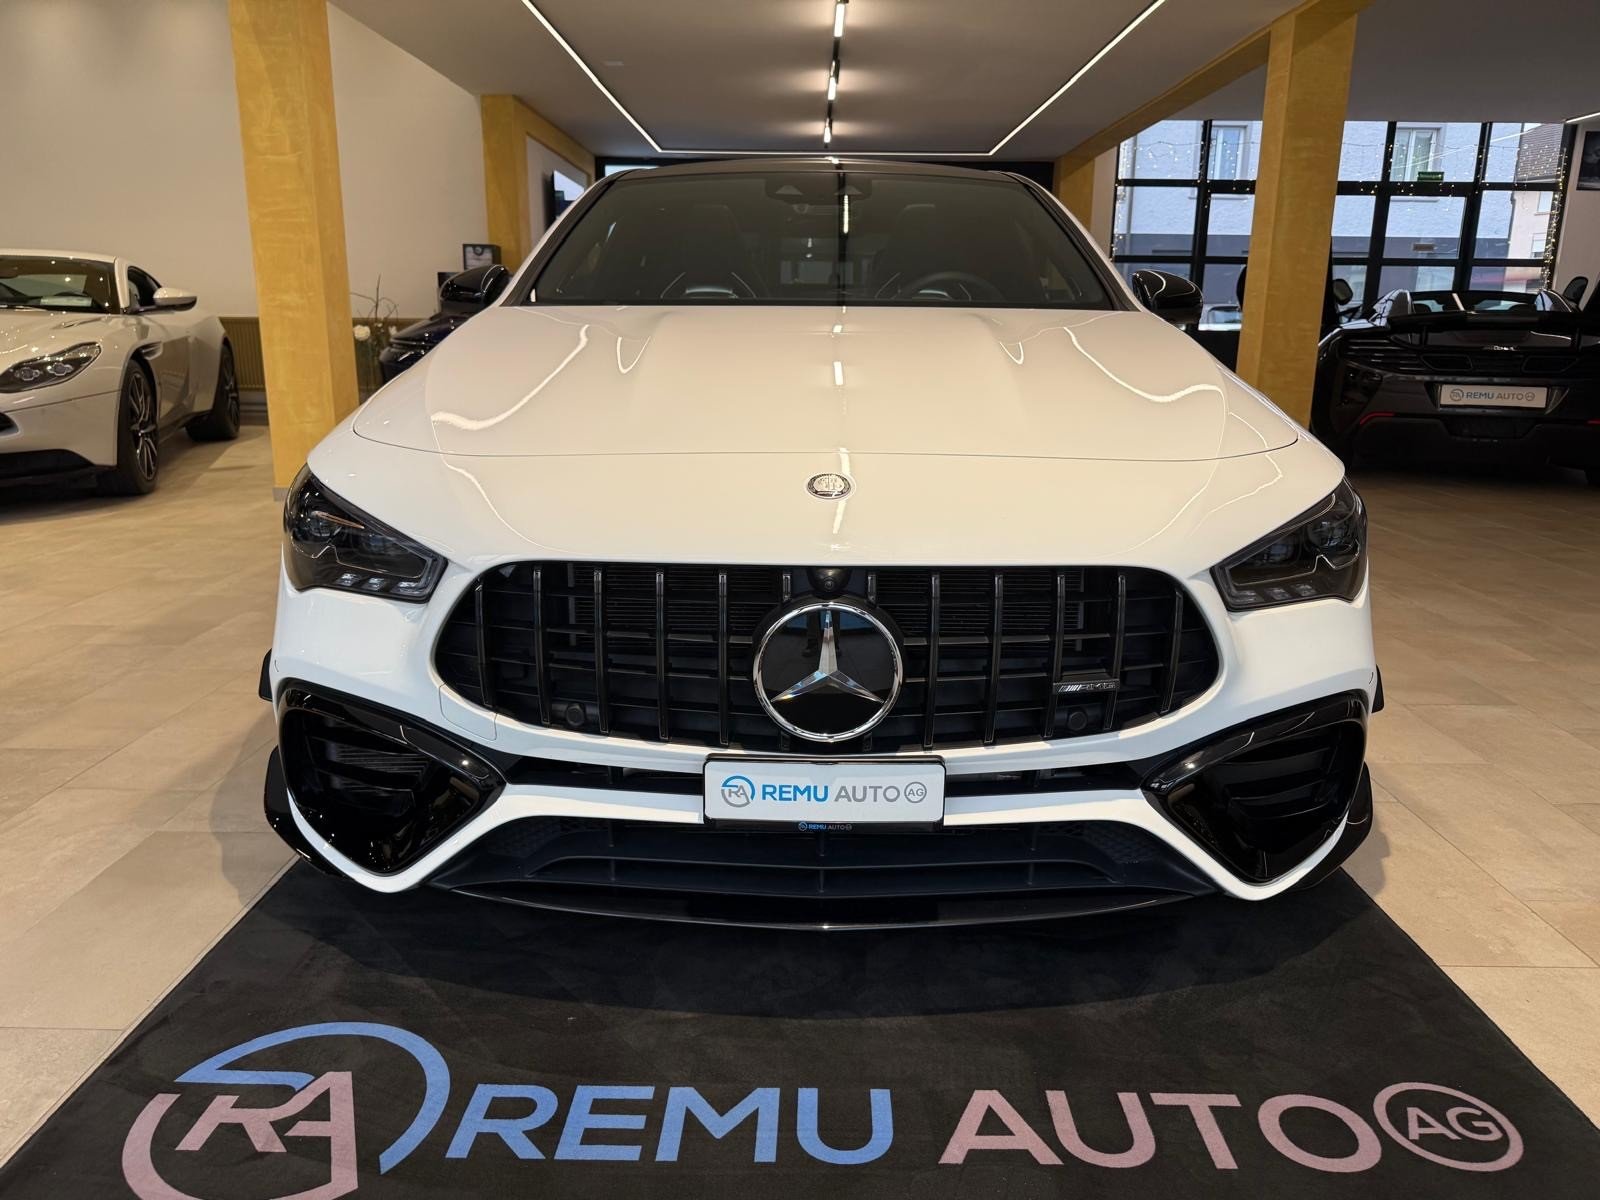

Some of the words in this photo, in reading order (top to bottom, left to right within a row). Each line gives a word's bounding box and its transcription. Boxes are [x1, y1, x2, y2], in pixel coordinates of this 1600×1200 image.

[1496, 392, 1523, 400] AUTO
[762, 784, 828, 802] REMU
[834, 785, 900, 802] AUTO
[907, 788, 924, 797] AG
[445, 1083, 894, 1165] REMU
[938, 1089, 1382, 1173] AUTO
[1406, 1106, 1504, 1142] AG
